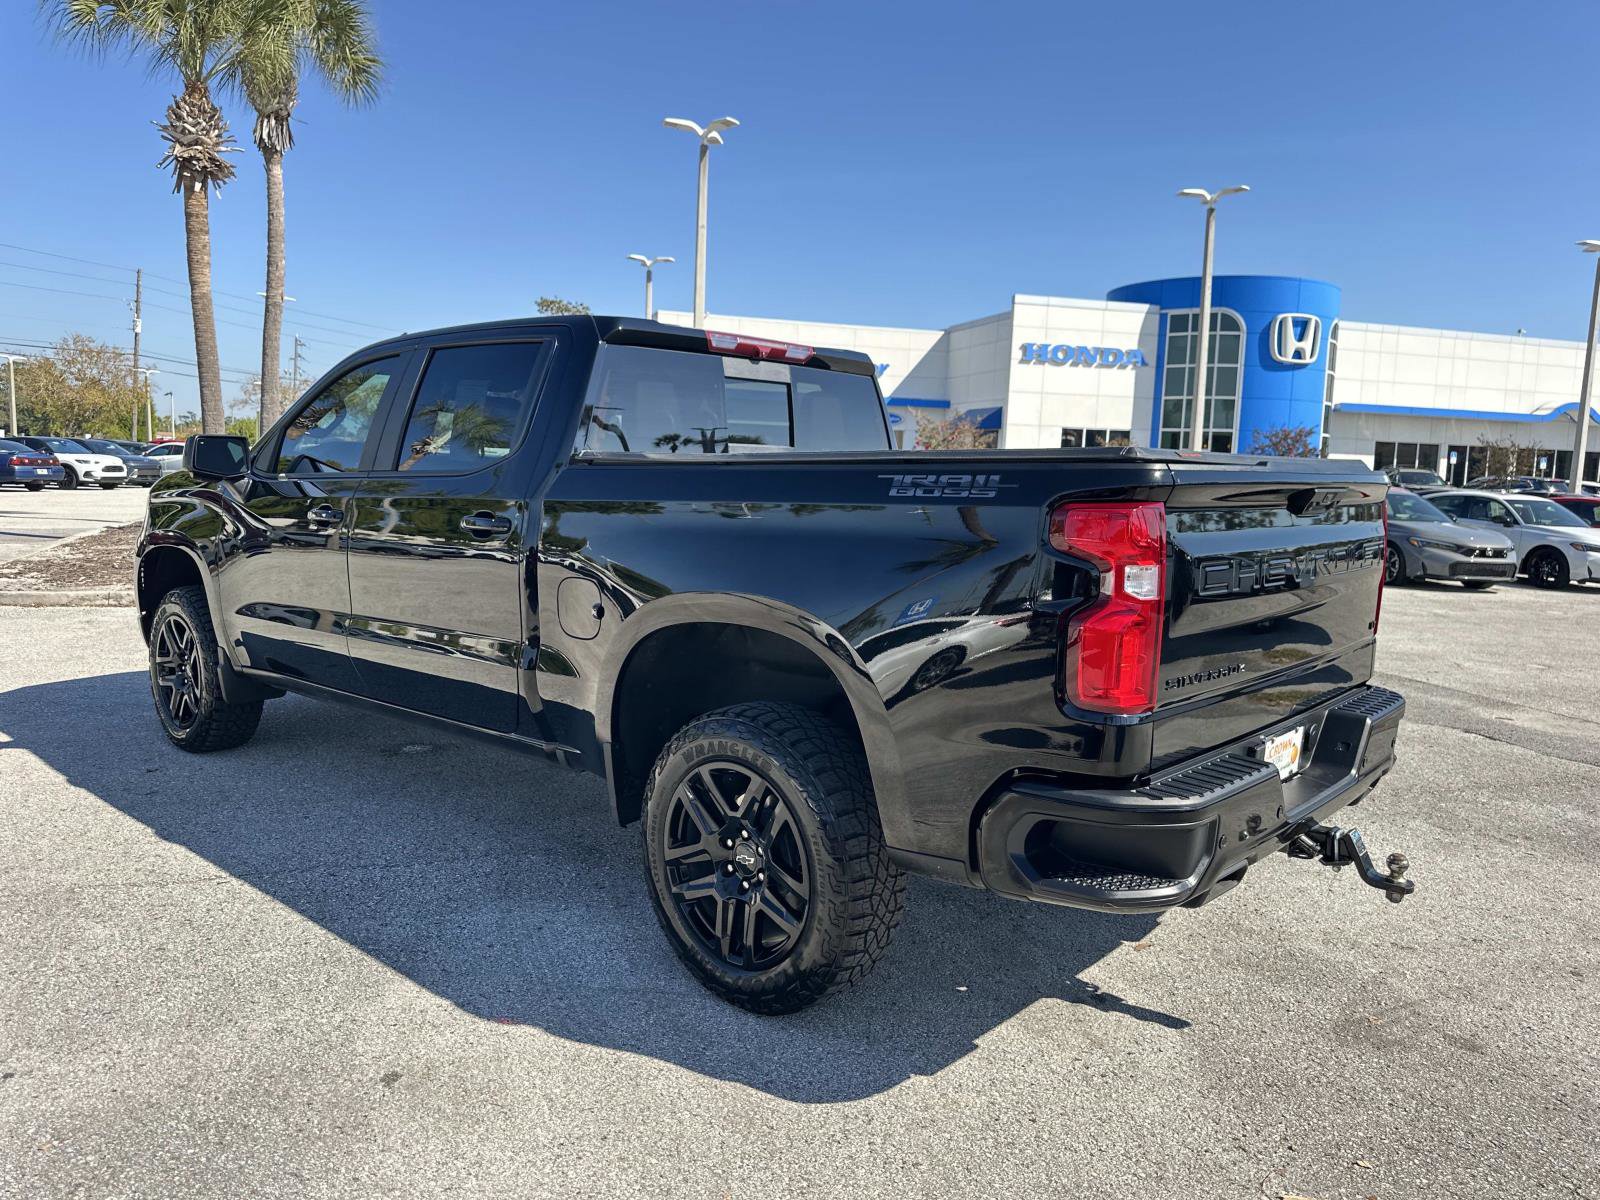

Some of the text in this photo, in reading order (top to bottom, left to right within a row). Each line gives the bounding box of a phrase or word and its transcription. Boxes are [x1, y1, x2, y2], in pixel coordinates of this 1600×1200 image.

[1019, 342, 1148, 368] HONDA
[878, 474, 1019, 488] TRAIL
[889, 487, 997, 498] BOSS
